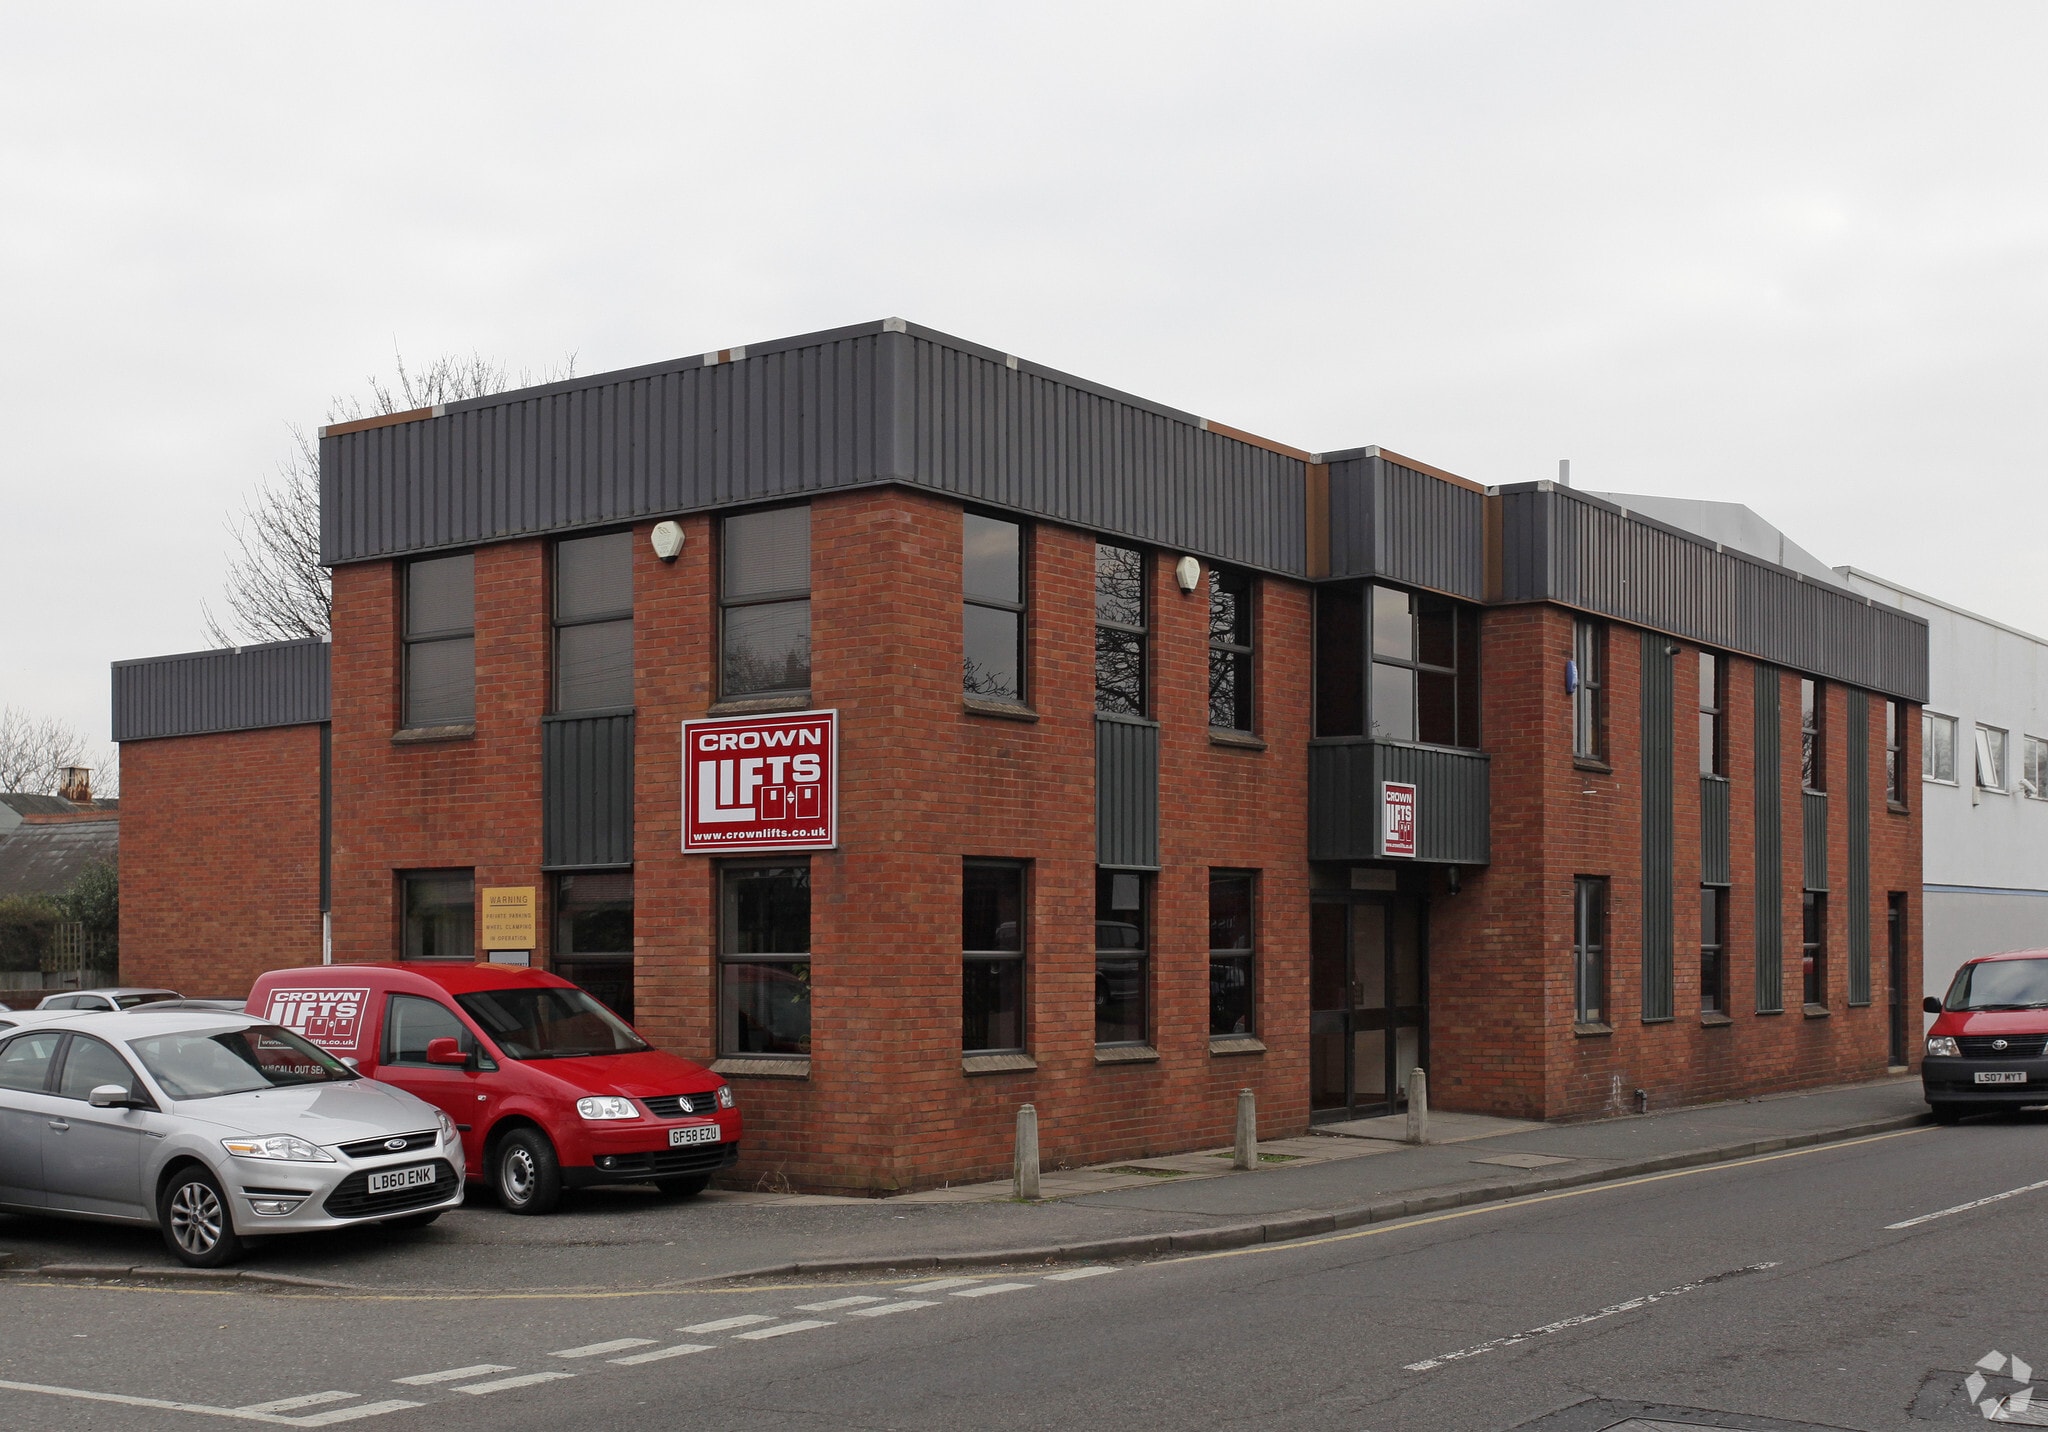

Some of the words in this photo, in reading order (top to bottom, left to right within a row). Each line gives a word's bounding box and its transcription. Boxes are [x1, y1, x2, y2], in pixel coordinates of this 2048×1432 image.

[699, 728, 821, 751] CROWN
[698, 753, 821, 823] LIFTS
[1386, 791, 1412, 803] CROWN
[1386, 803, 1412, 840] LIFTS
[693, 827, 826, 841] www.crownlifts.co.uk
[490, 895, 528, 904] WARNING
[275, 992, 362, 1001] CROWN
[269, 1002, 358, 1035] LIFTS
[275, 1065, 293, 1074] CALL
[294, 1065, 310, 1074] OUT
[1978, 1073, 2002, 1082] LS07
[2004, 1072, 2023, 1081] MYT
[673, 1129, 698, 1143] GF58
[700, 1127, 717, 1141] EZU
[373, 1172, 405, 1190] LB60
[408, 1167, 431, 1185] ENK
